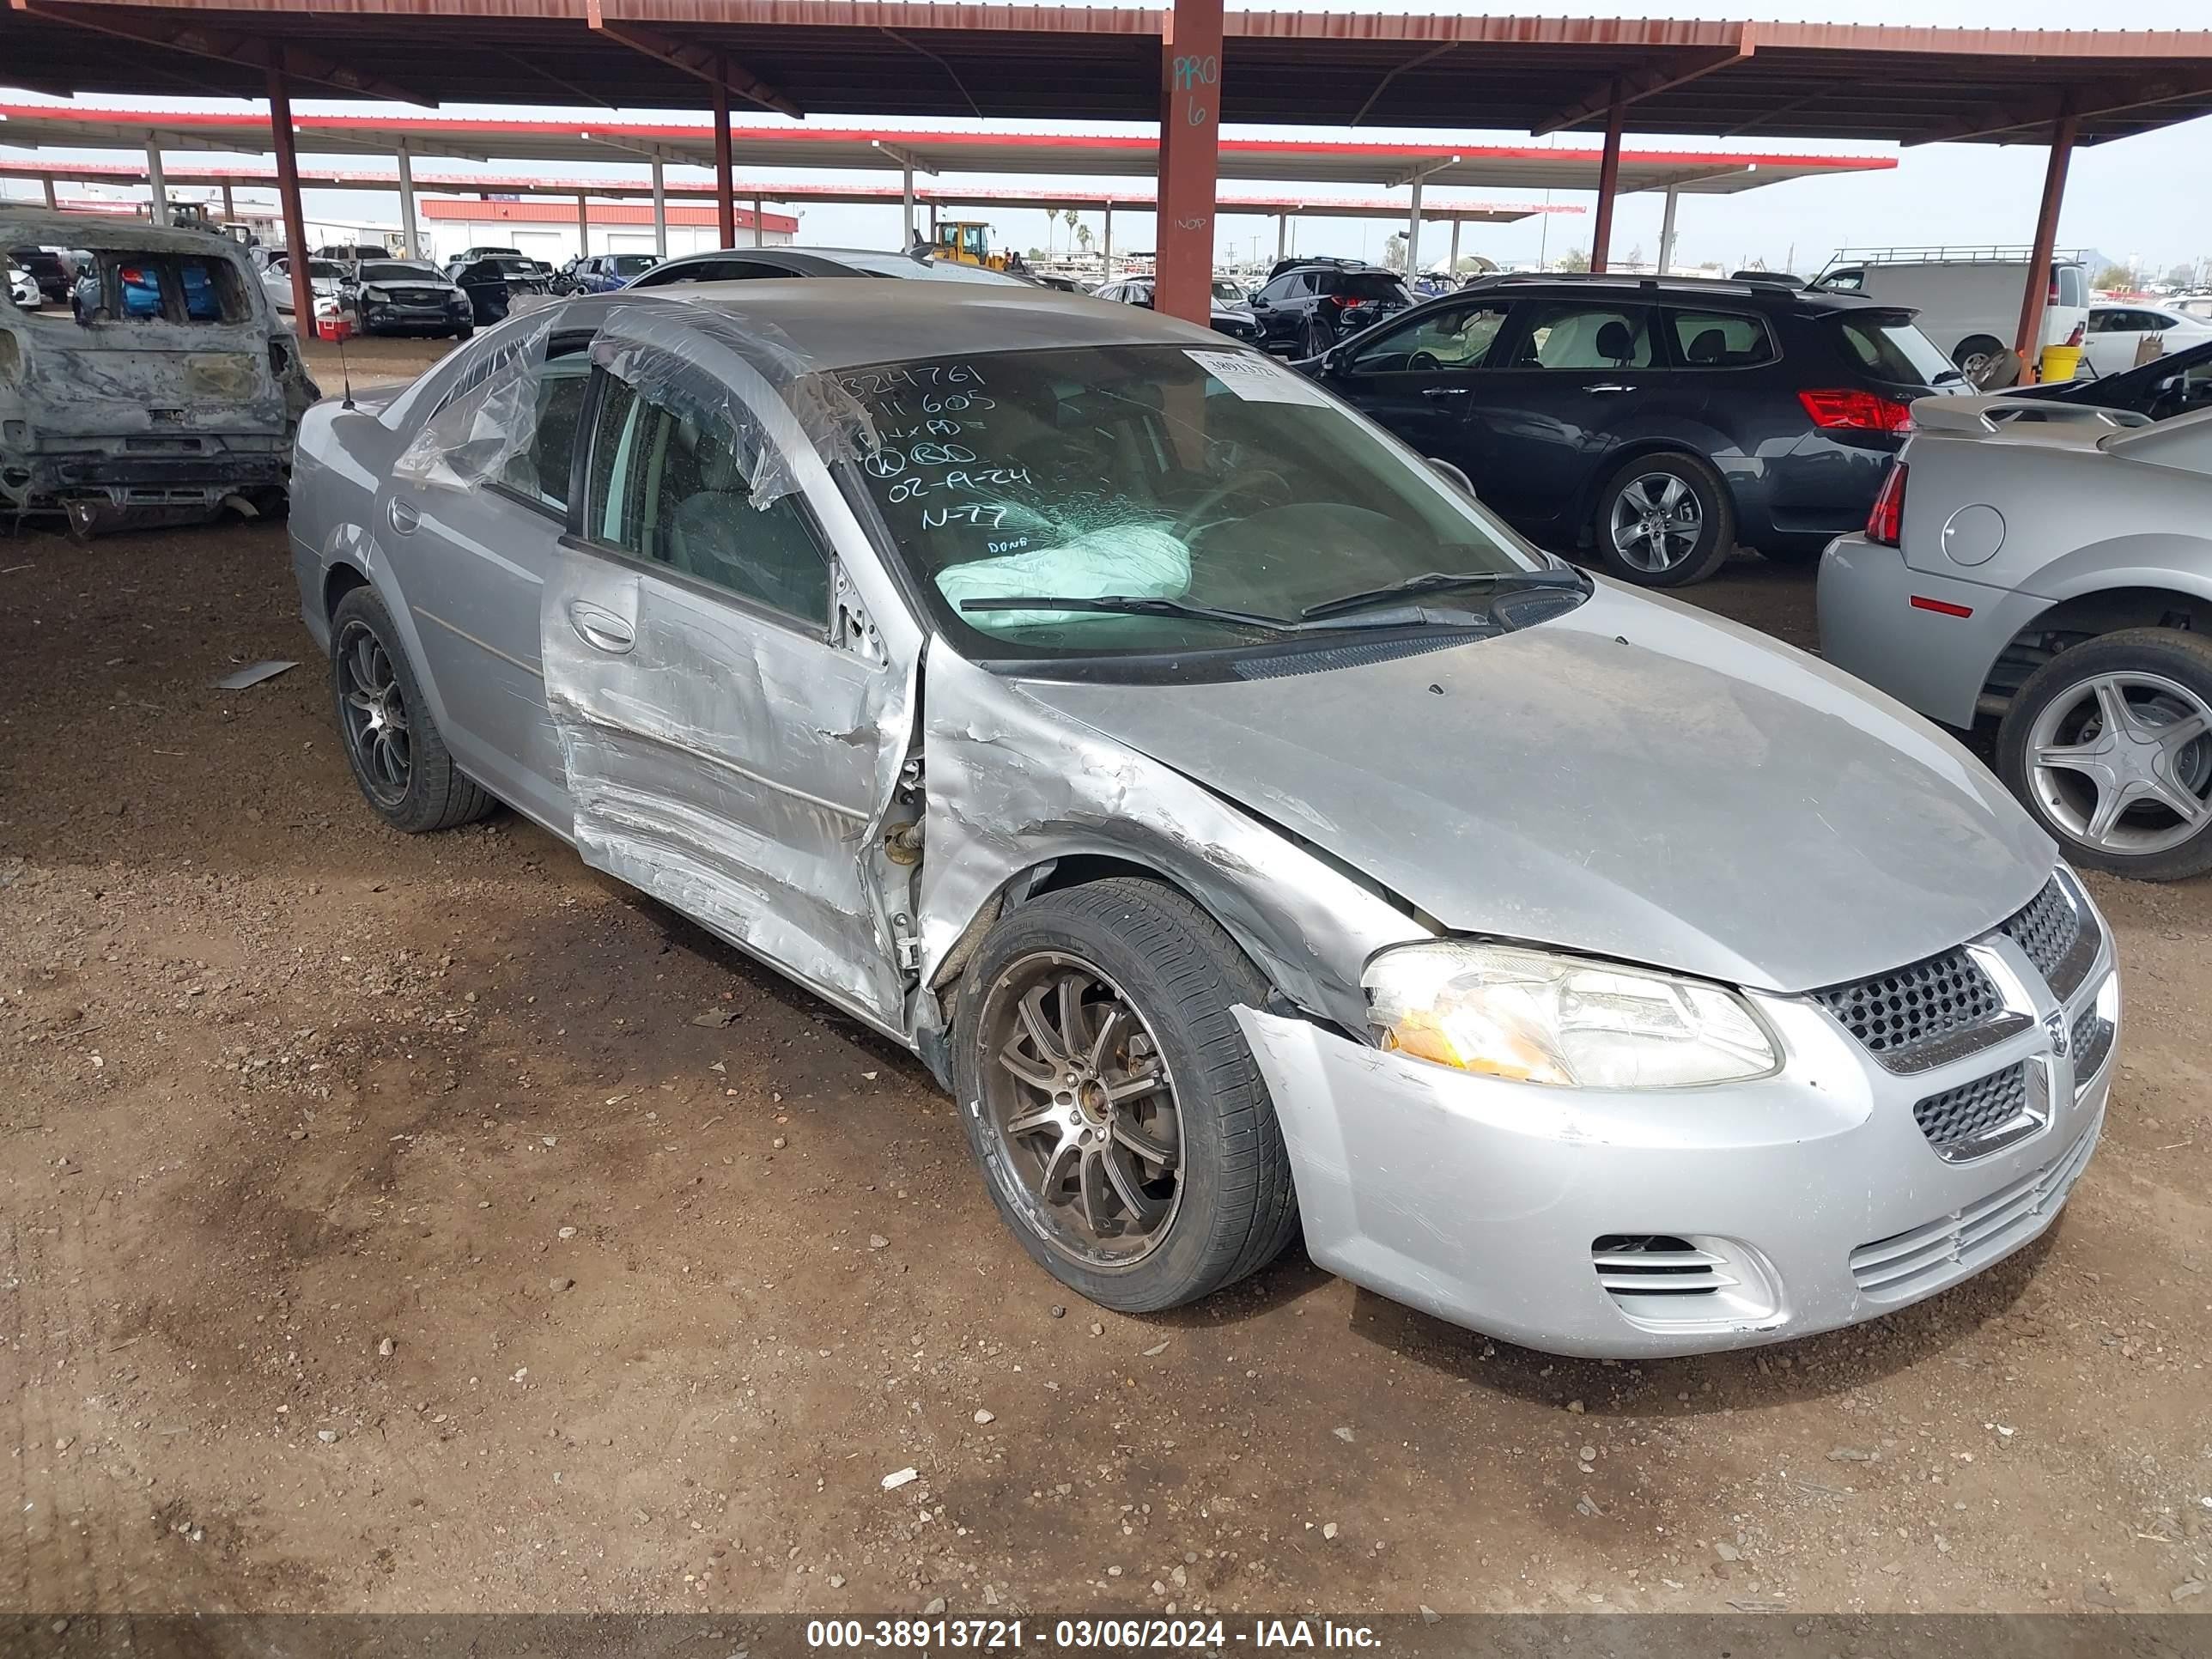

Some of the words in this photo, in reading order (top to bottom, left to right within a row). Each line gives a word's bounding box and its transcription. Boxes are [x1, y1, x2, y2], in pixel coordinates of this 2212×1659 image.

[1173, 55, 1217, 90] PRO
[1188, 95, 1206, 126] 6
[1206, 360, 1281, 379] 38913721
[922, 389, 997, 413] 605
